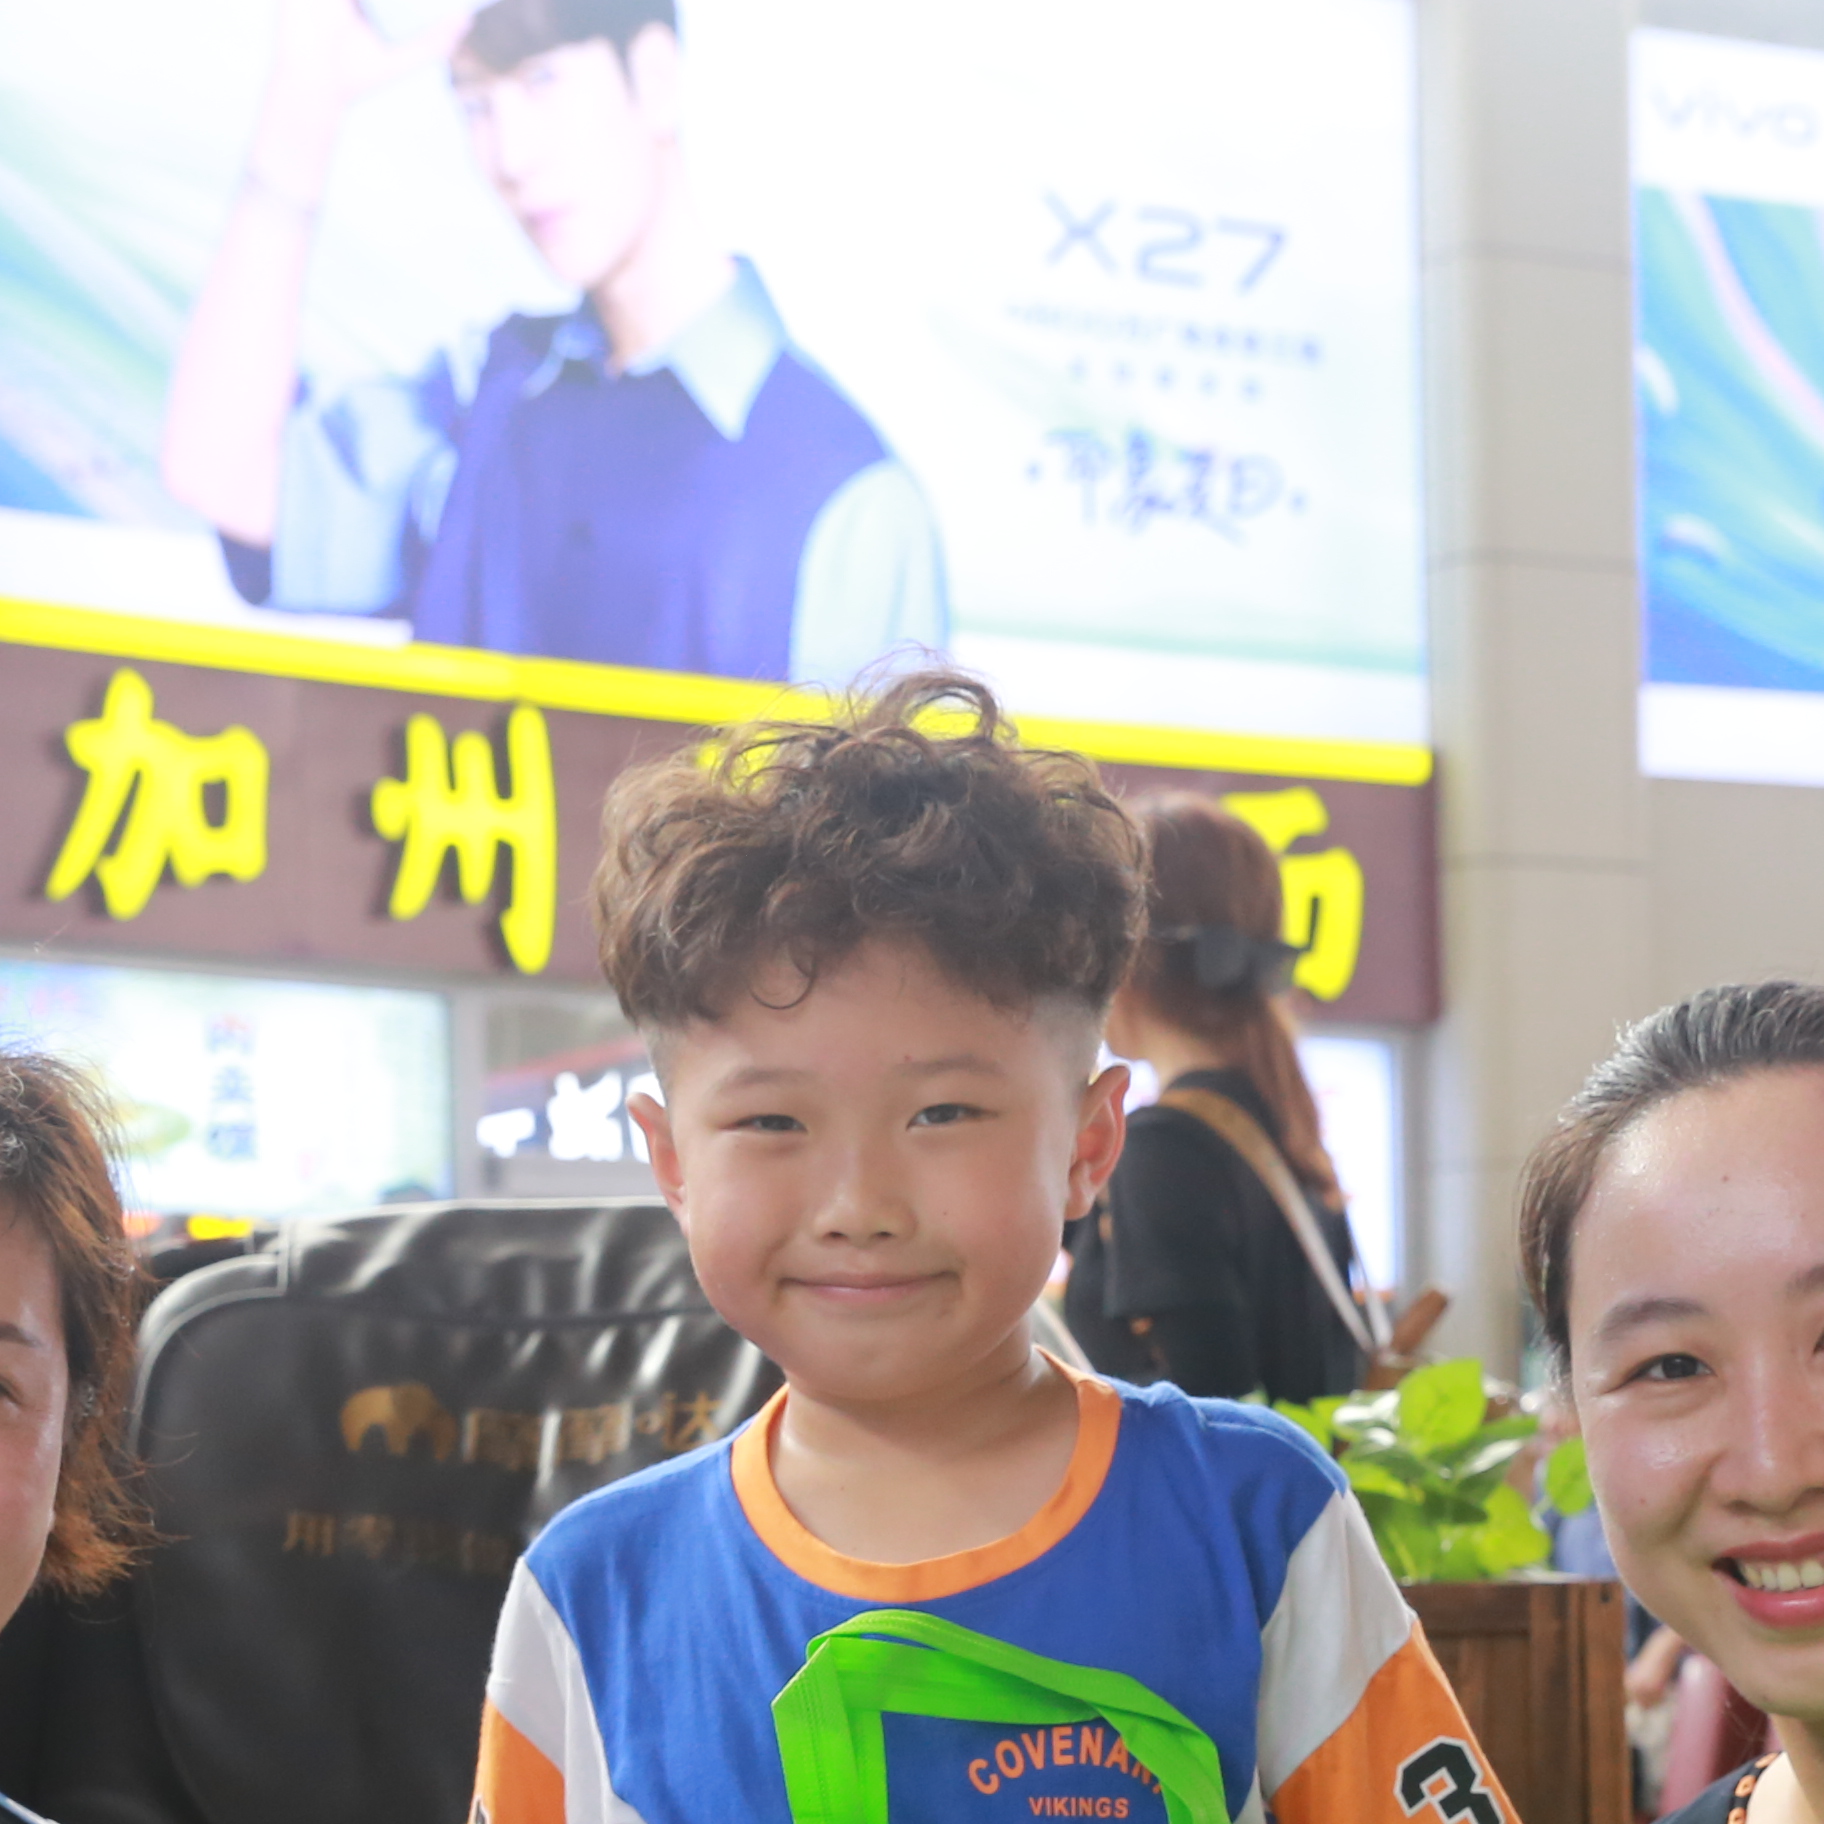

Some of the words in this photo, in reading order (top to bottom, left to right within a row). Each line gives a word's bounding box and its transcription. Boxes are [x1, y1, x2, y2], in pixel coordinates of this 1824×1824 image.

[1649, 78, 1823, 151] vivo
[1039, 186, 1288, 297] X27
[968, 1726, 1161, 1795] COVENA
[1029, 1796, 1130, 1819] VIKINGS
